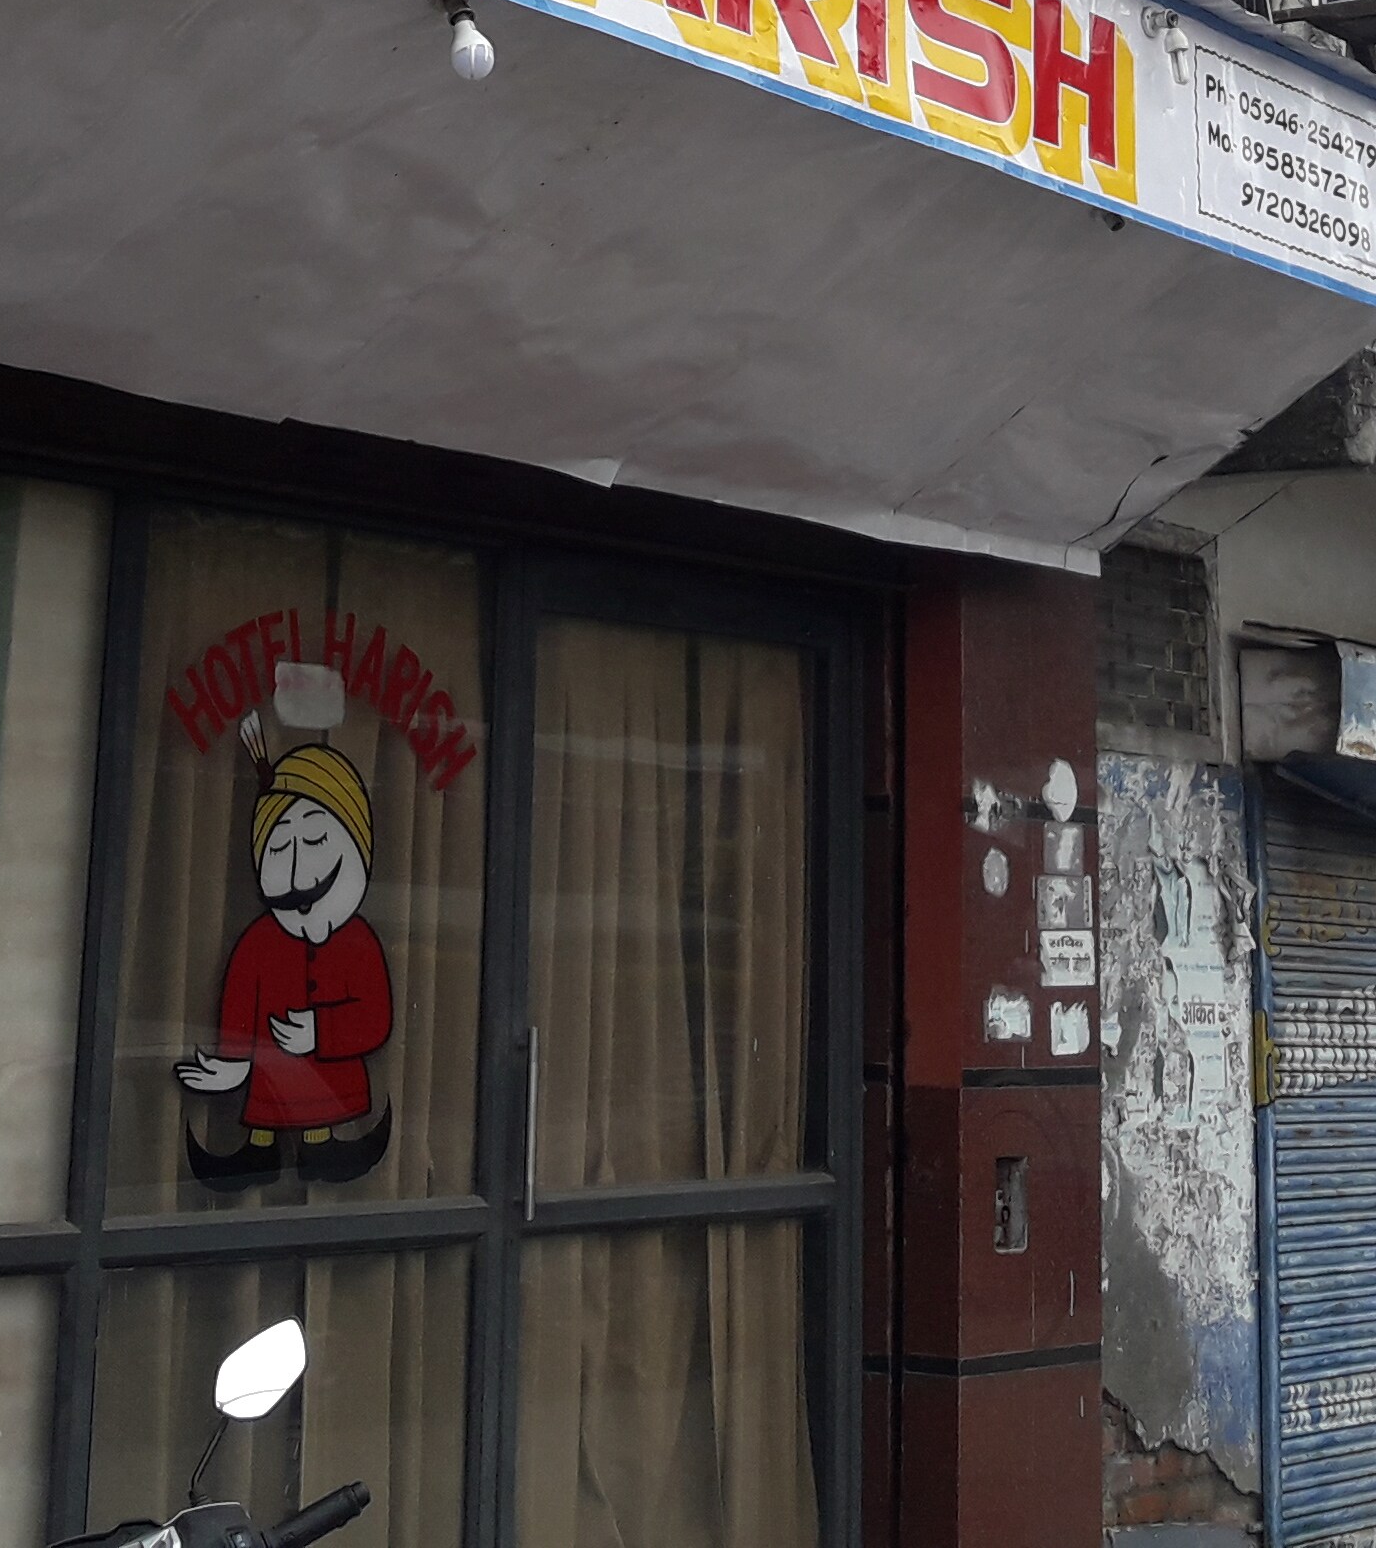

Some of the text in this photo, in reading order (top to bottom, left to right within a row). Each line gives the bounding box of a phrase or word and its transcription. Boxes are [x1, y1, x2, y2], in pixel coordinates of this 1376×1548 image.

[1241, 136, 1370, 209] 8958357278
[1241, 181, 1371, 252] 9720326098
[324, 606, 478, 792] HARISH
